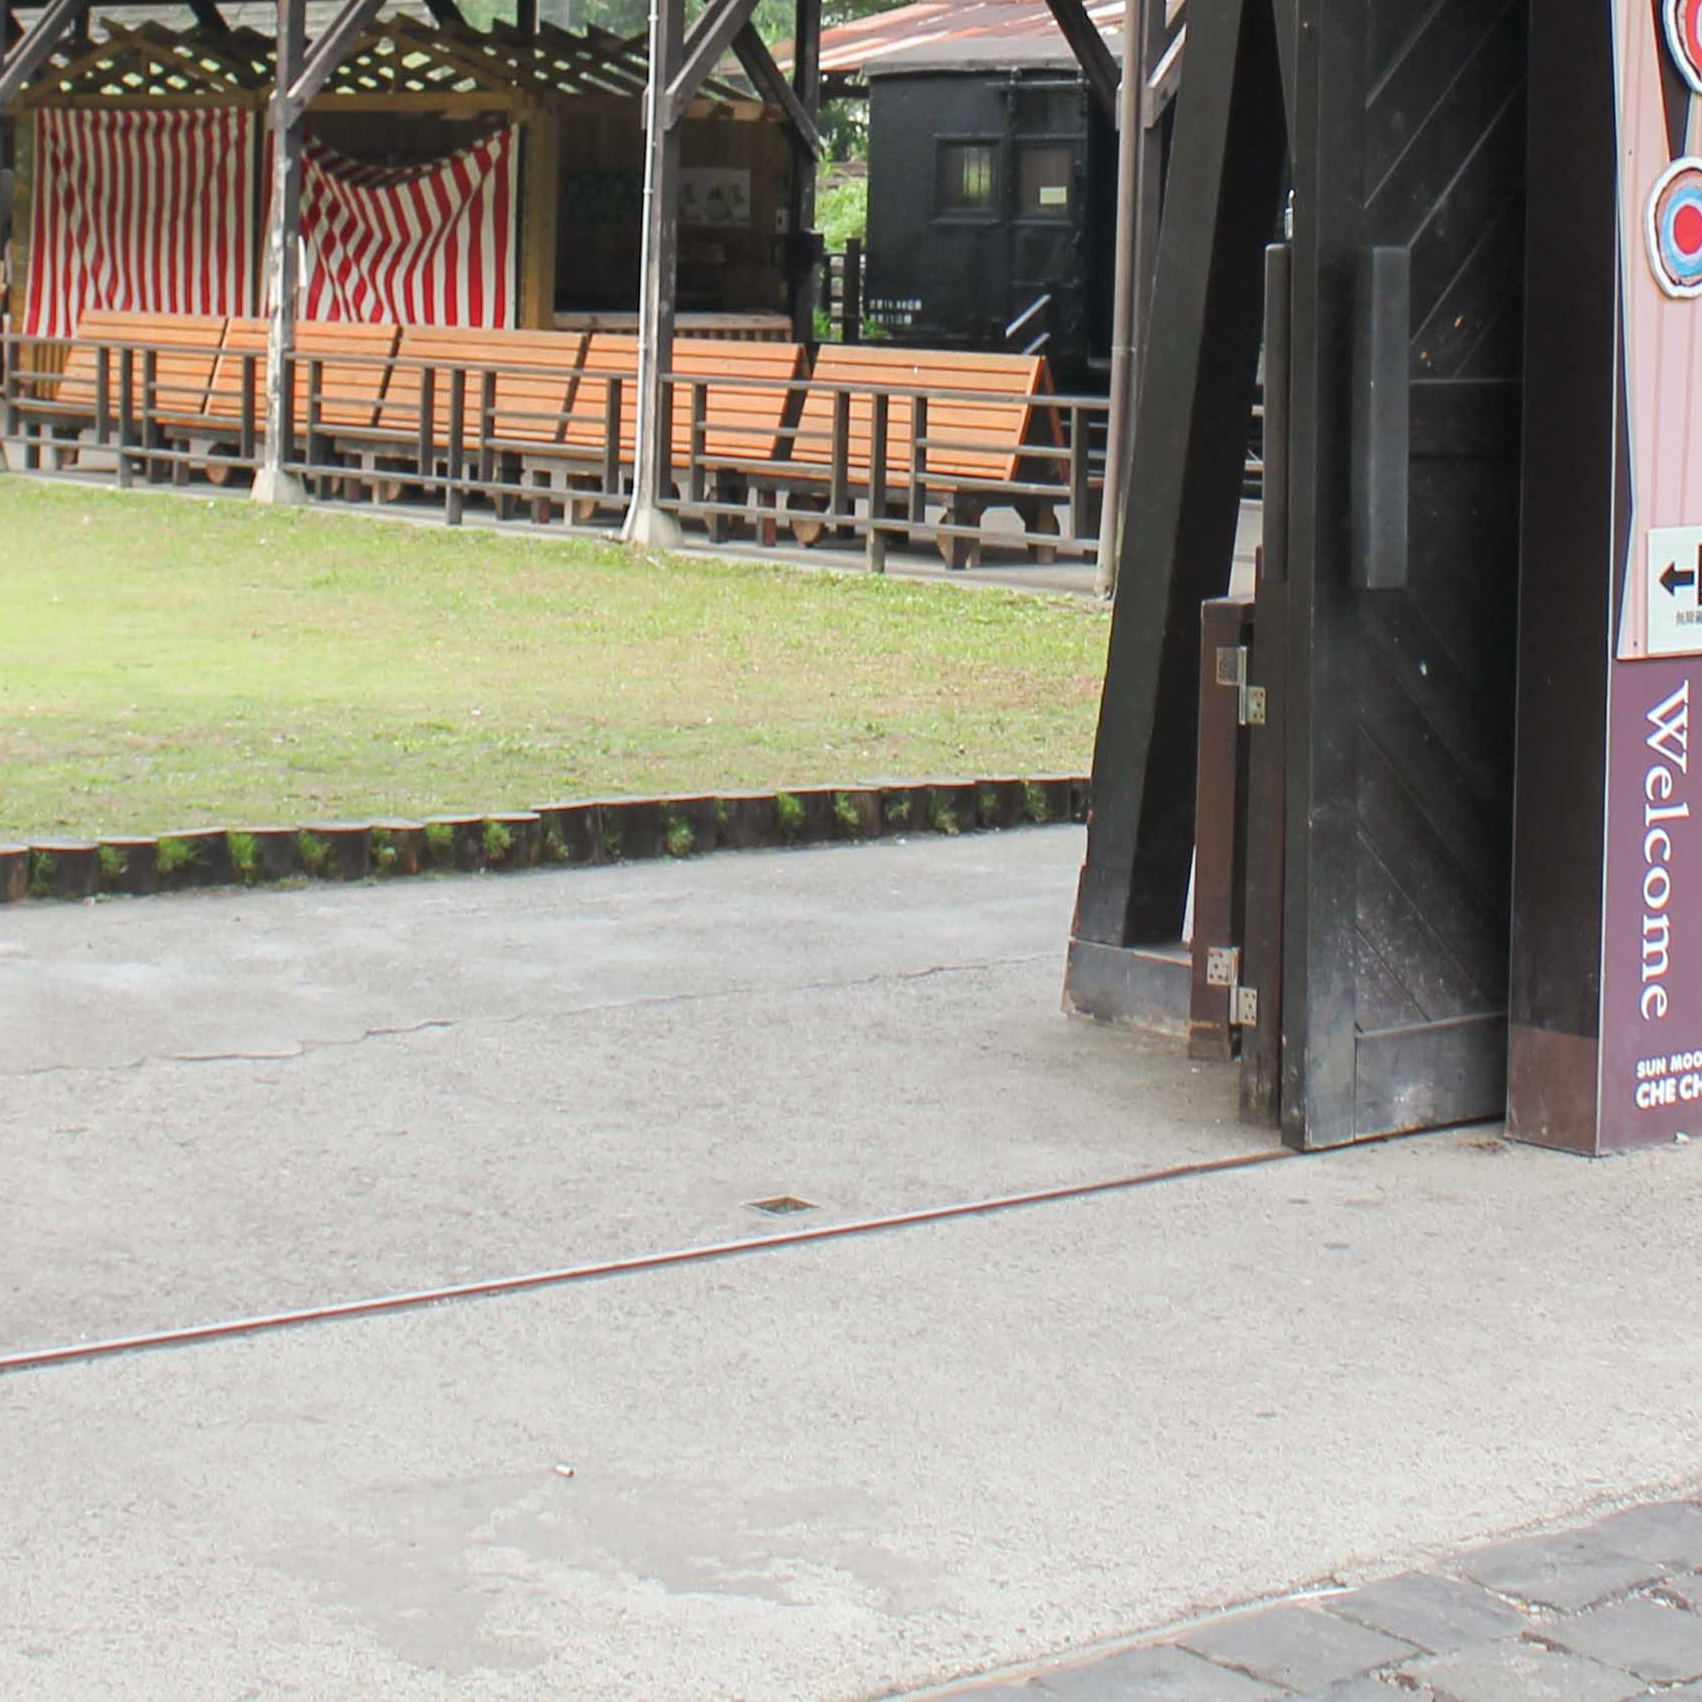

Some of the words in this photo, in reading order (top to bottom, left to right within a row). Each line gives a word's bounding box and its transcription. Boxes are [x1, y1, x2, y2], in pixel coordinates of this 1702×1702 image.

[1642, 678, 1690, 1021] Welcome
[1636, 1056, 1666, 1079] SUN
[1636, 1077, 1677, 1109] CHE
